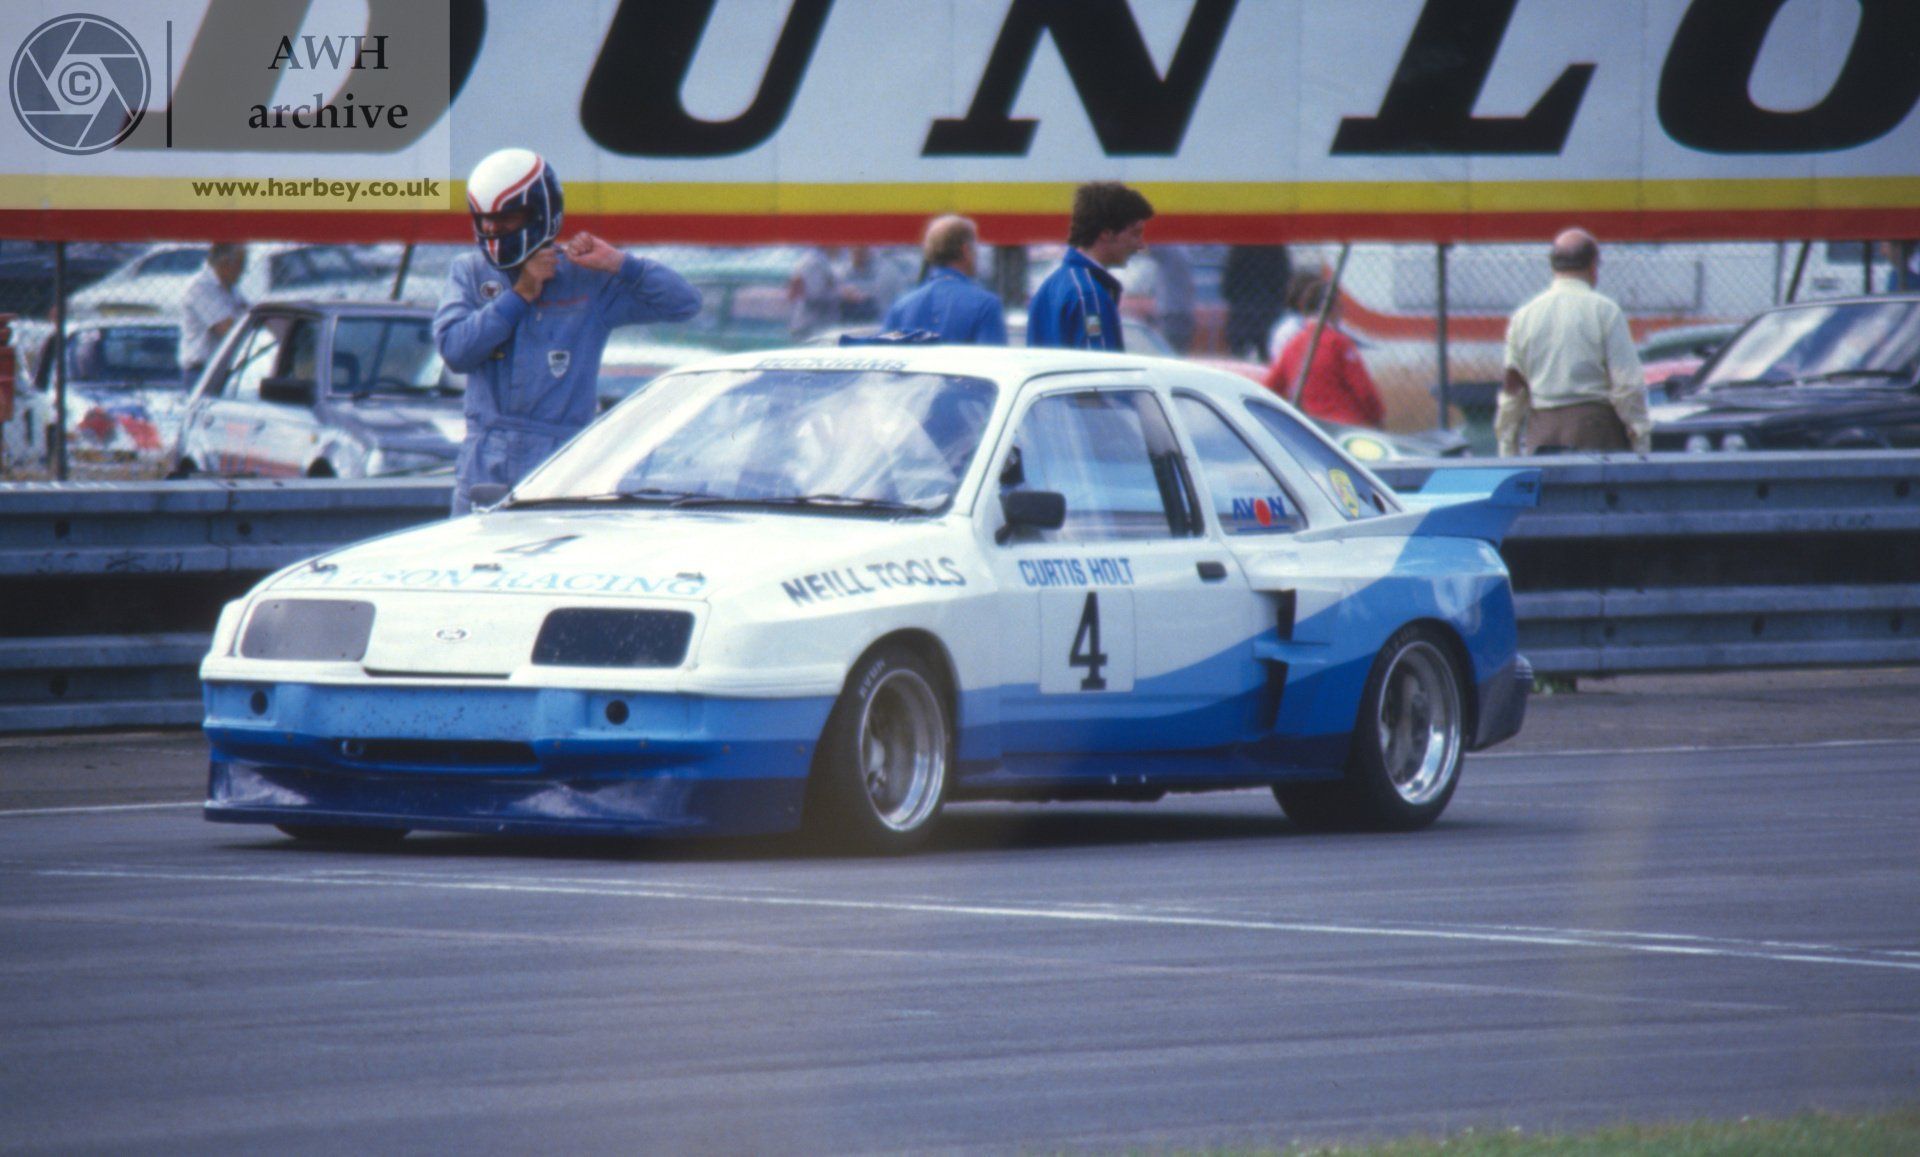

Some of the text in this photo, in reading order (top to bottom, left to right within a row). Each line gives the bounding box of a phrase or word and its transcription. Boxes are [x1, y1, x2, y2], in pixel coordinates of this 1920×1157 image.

[1232, 495, 1288, 528] AVON
[495, 533, 579, 558] 4
[487, 569, 707, 596] RACING
[781, 556, 967, 608] NEILL TOOLS
[1017, 557, 1135, 587] CURTIS HOLT
[1069, 591, 1108, 691] 4
